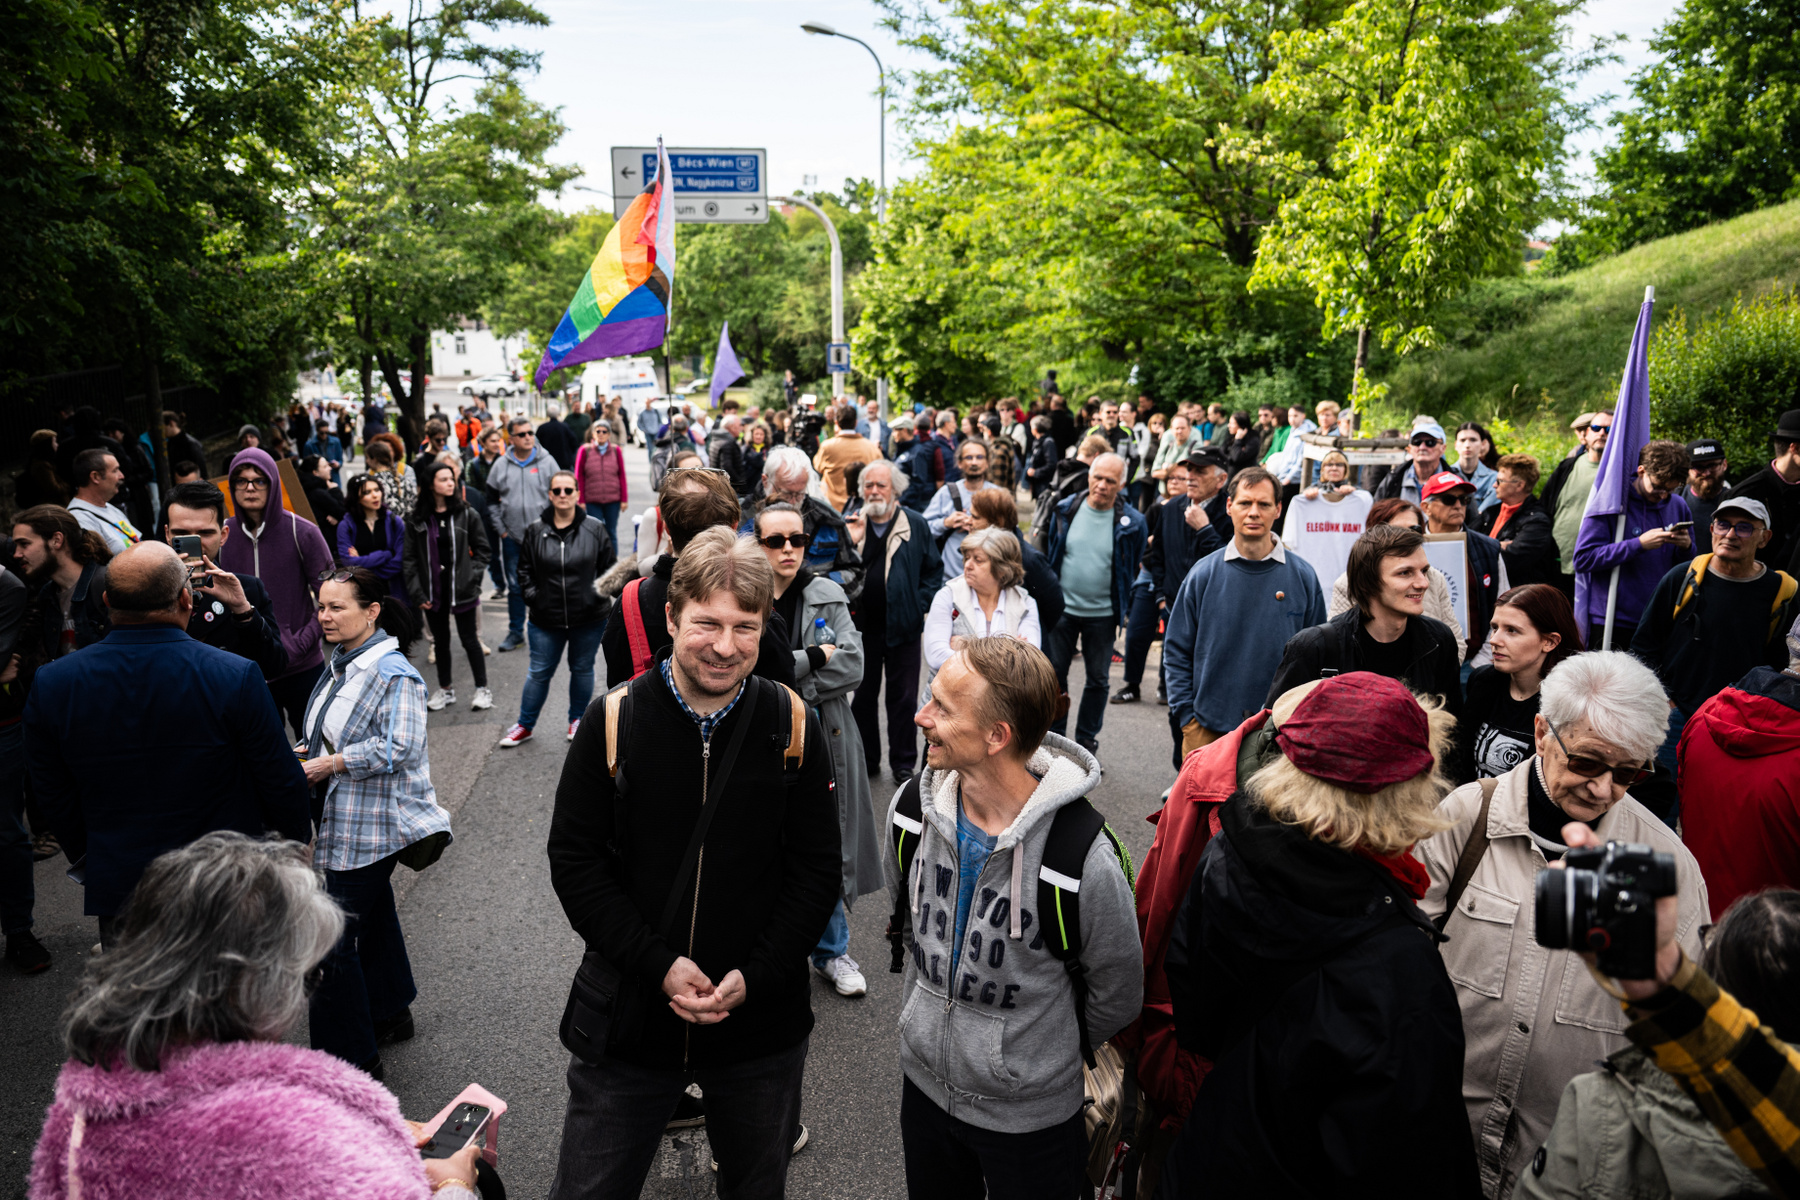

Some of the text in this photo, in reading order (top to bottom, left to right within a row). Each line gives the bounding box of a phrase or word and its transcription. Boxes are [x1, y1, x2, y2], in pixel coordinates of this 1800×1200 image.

[677, 157, 734, 168] Bécs-Wien
[687, 177, 735, 189] Nagykanizsa
[1306, 521, 1361, 534] ELEGÜNK VAN!
